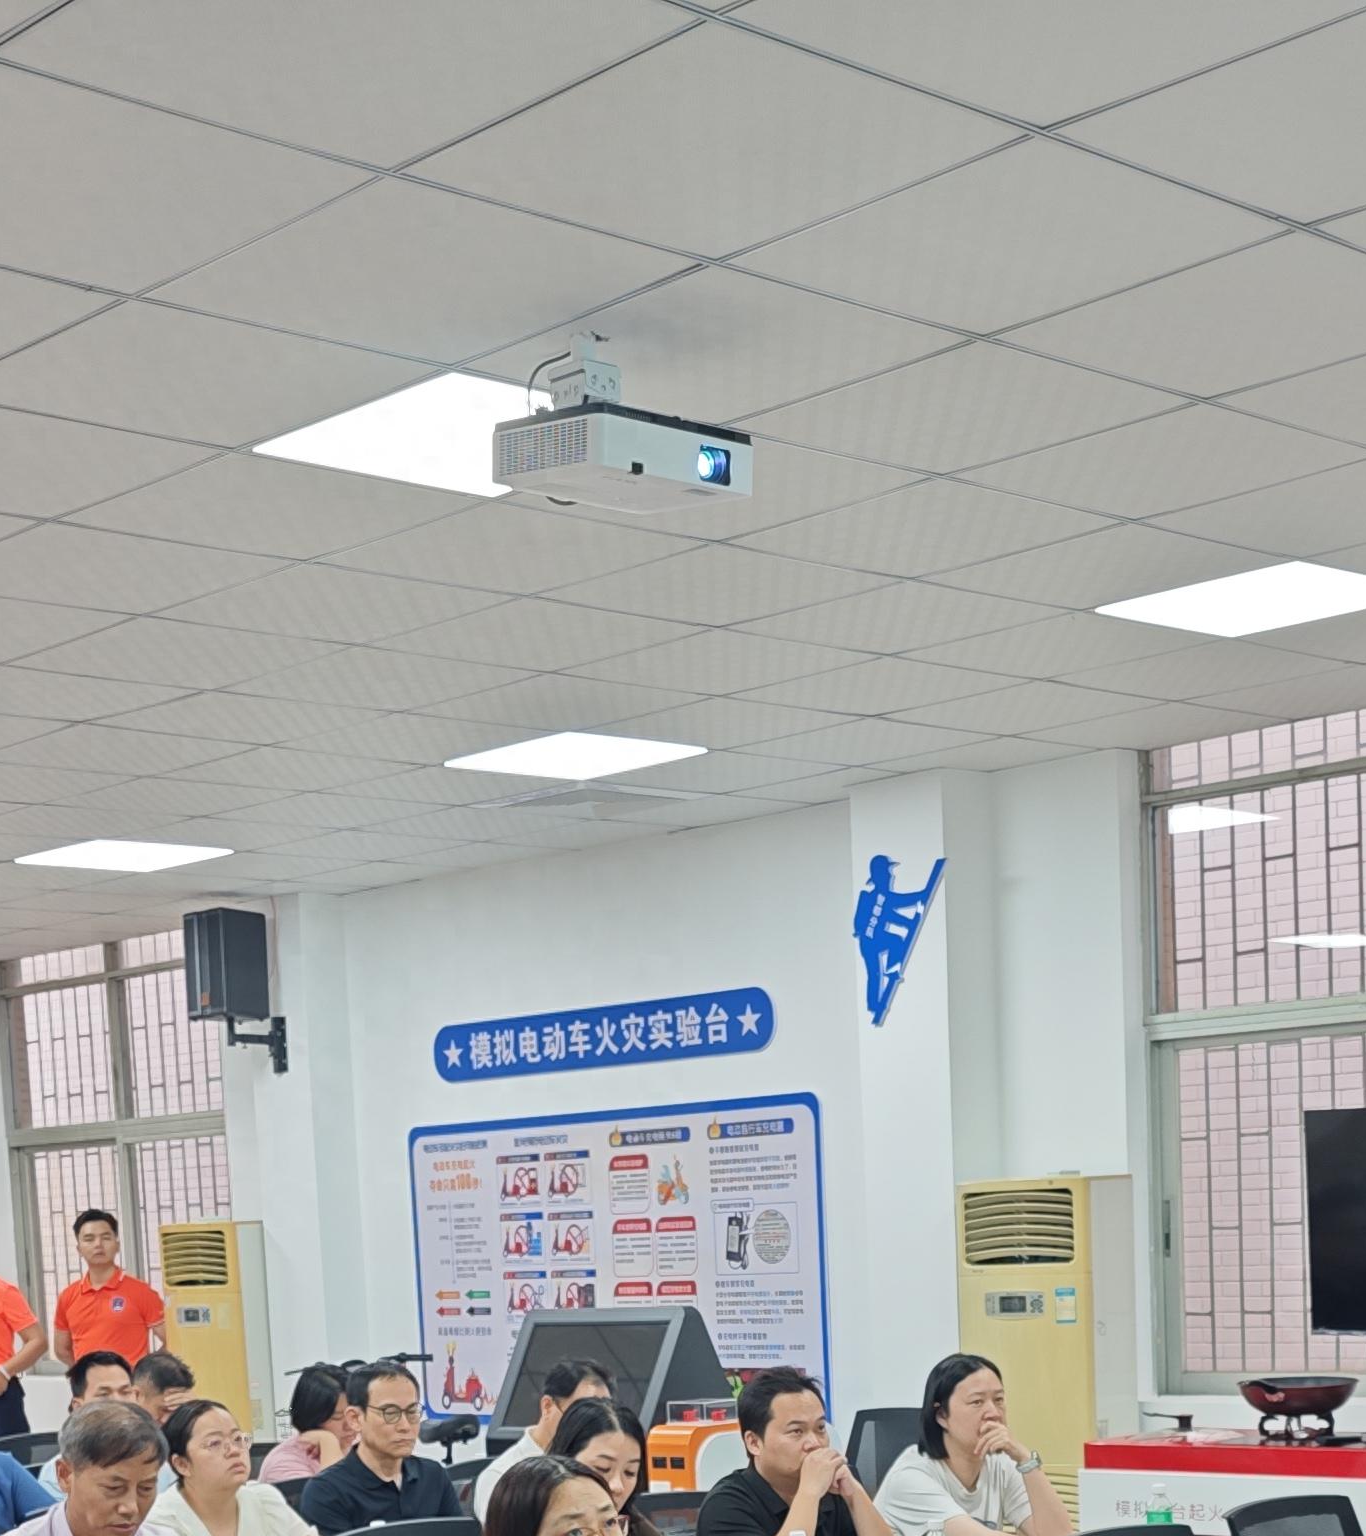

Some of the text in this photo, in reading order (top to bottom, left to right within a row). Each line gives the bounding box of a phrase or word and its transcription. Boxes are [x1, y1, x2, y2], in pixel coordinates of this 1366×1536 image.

[469, 1002, 730, 1071] 模拟电动车火灾实验台
[1115, 1499, 1225, 1522] 模拟台起火
